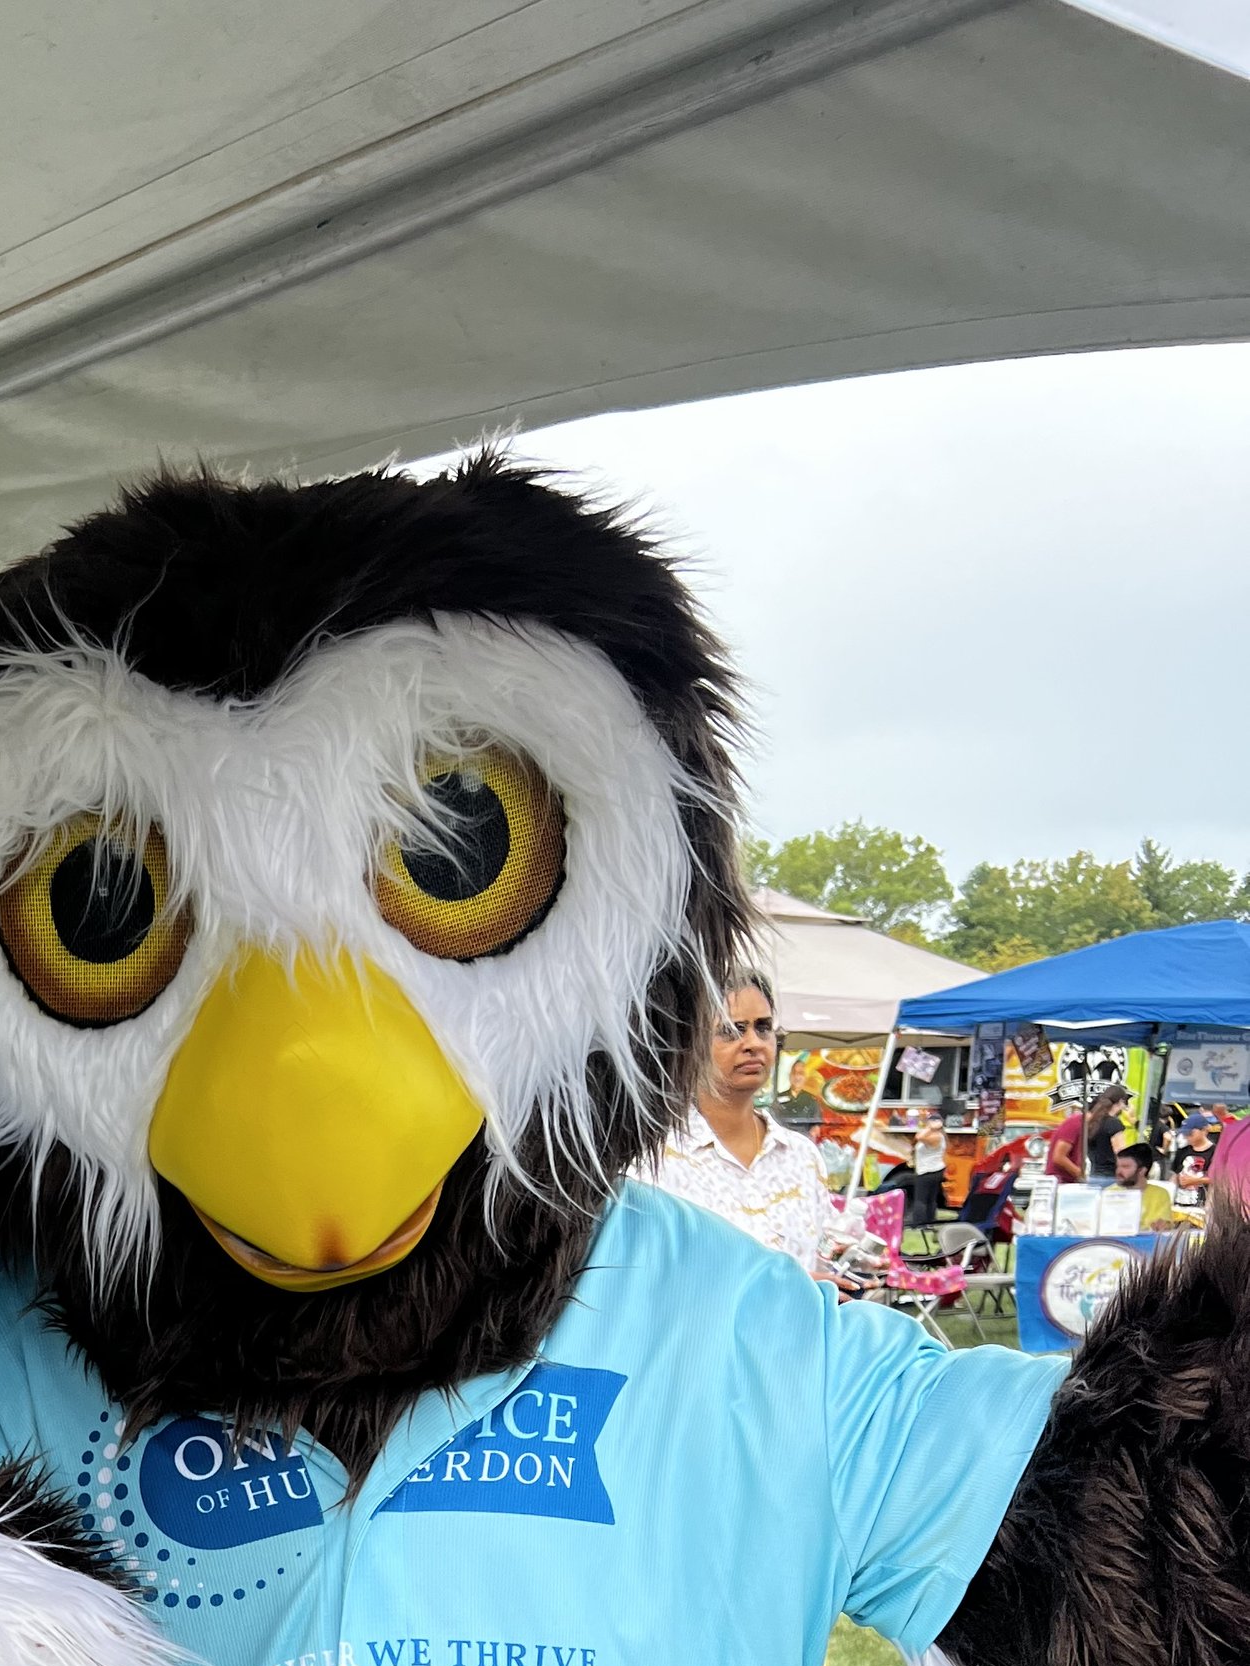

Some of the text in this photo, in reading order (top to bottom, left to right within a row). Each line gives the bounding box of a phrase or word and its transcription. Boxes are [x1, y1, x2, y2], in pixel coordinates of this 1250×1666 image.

[174, 1389, 578, 1481] ON ICE
[196, 1449, 576, 1514] OF HU ERDON
